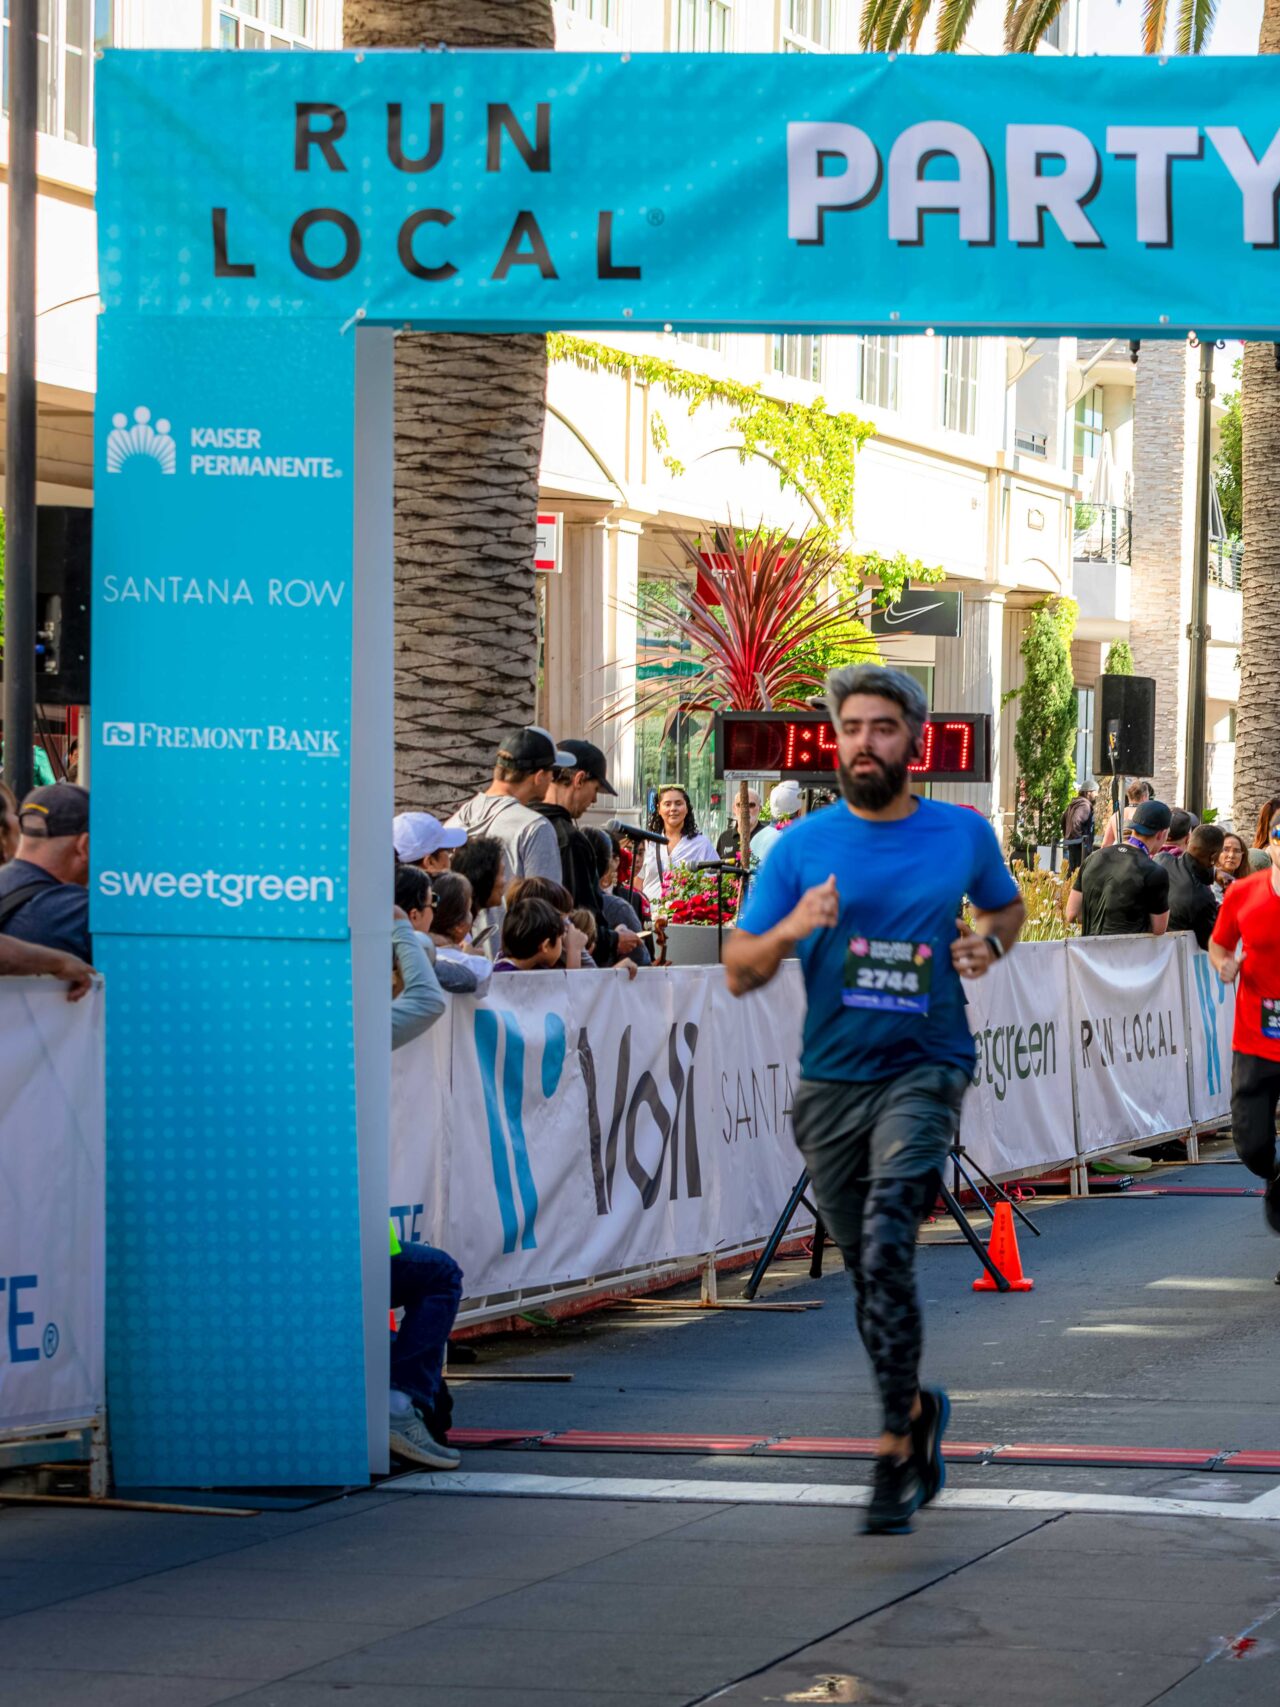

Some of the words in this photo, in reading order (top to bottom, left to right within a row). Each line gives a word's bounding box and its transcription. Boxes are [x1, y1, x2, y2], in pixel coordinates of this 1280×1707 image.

[294, 101, 552, 173] RUN
[191, 427, 262, 449] KAISER
[103, 575, 253, 605] SANTANA
[268, 579, 345, 607] ROW
[100, 870, 333, 907] sweetgreen
[972, 1019, 1057, 1102] etgreen
[1123, 1009, 1177, 1063] LOCAL
[577, 1021, 703, 1216] Voli
[721, 1063, 797, 1144] SANTA
